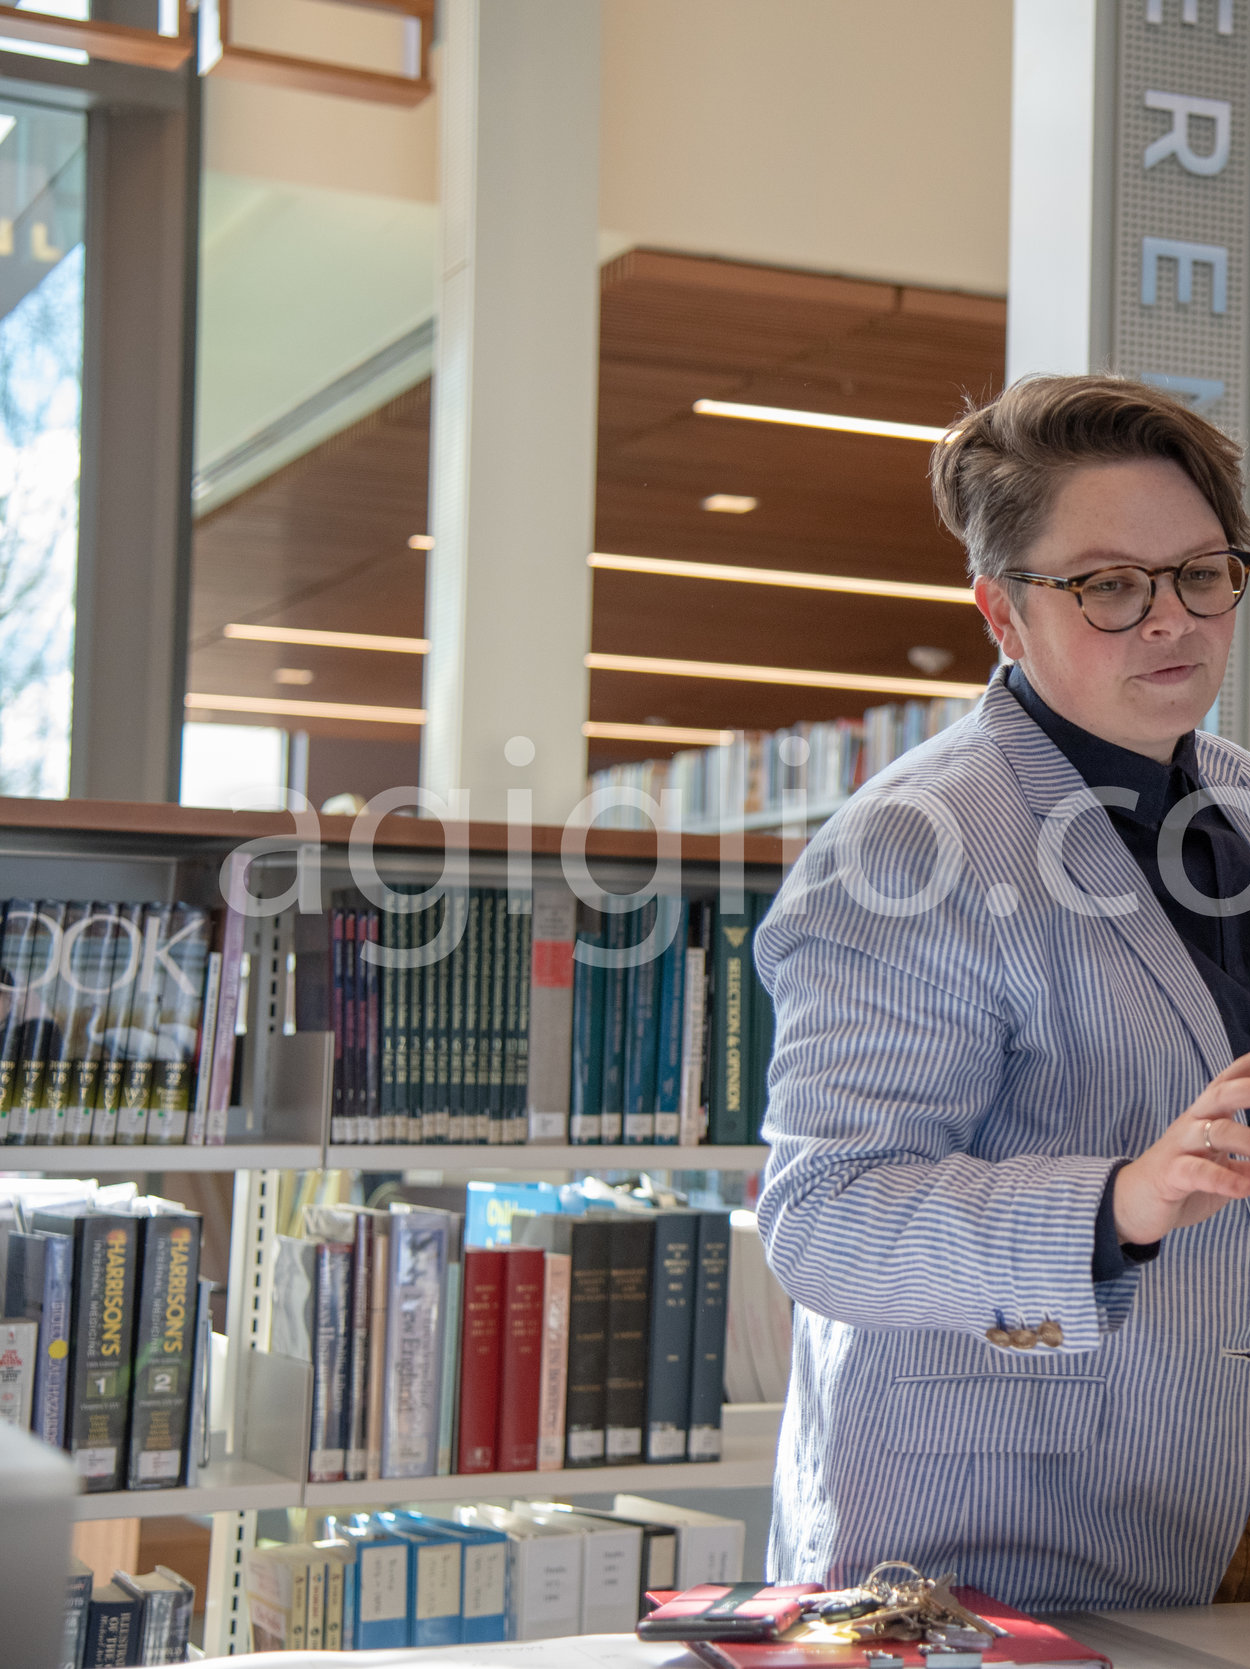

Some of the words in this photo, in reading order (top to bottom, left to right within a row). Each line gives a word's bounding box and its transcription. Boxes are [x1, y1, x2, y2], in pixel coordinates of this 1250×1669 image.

[1141, 0, 1236, 412] RE
[726, 957, 742, 1034] SELECTION
[726, 1035, 742, 1048] &
[726, 1049, 742, 1112] OPINION
[90, 1240, 102, 1297] INTERNAL
[153, 1237, 165, 1295] INTERNAL
[163, 1237, 191, 1354] HARRISON'S
[101, 1239, 126, 1357] HARRISON'S
[48, 1301, 66, 1379] BIOLOCAL
[87, 1300, 99, 1358] MEDICINE
[95, 1377, 106, 1396] 1
[153, 1373, 172, 1393] 2
